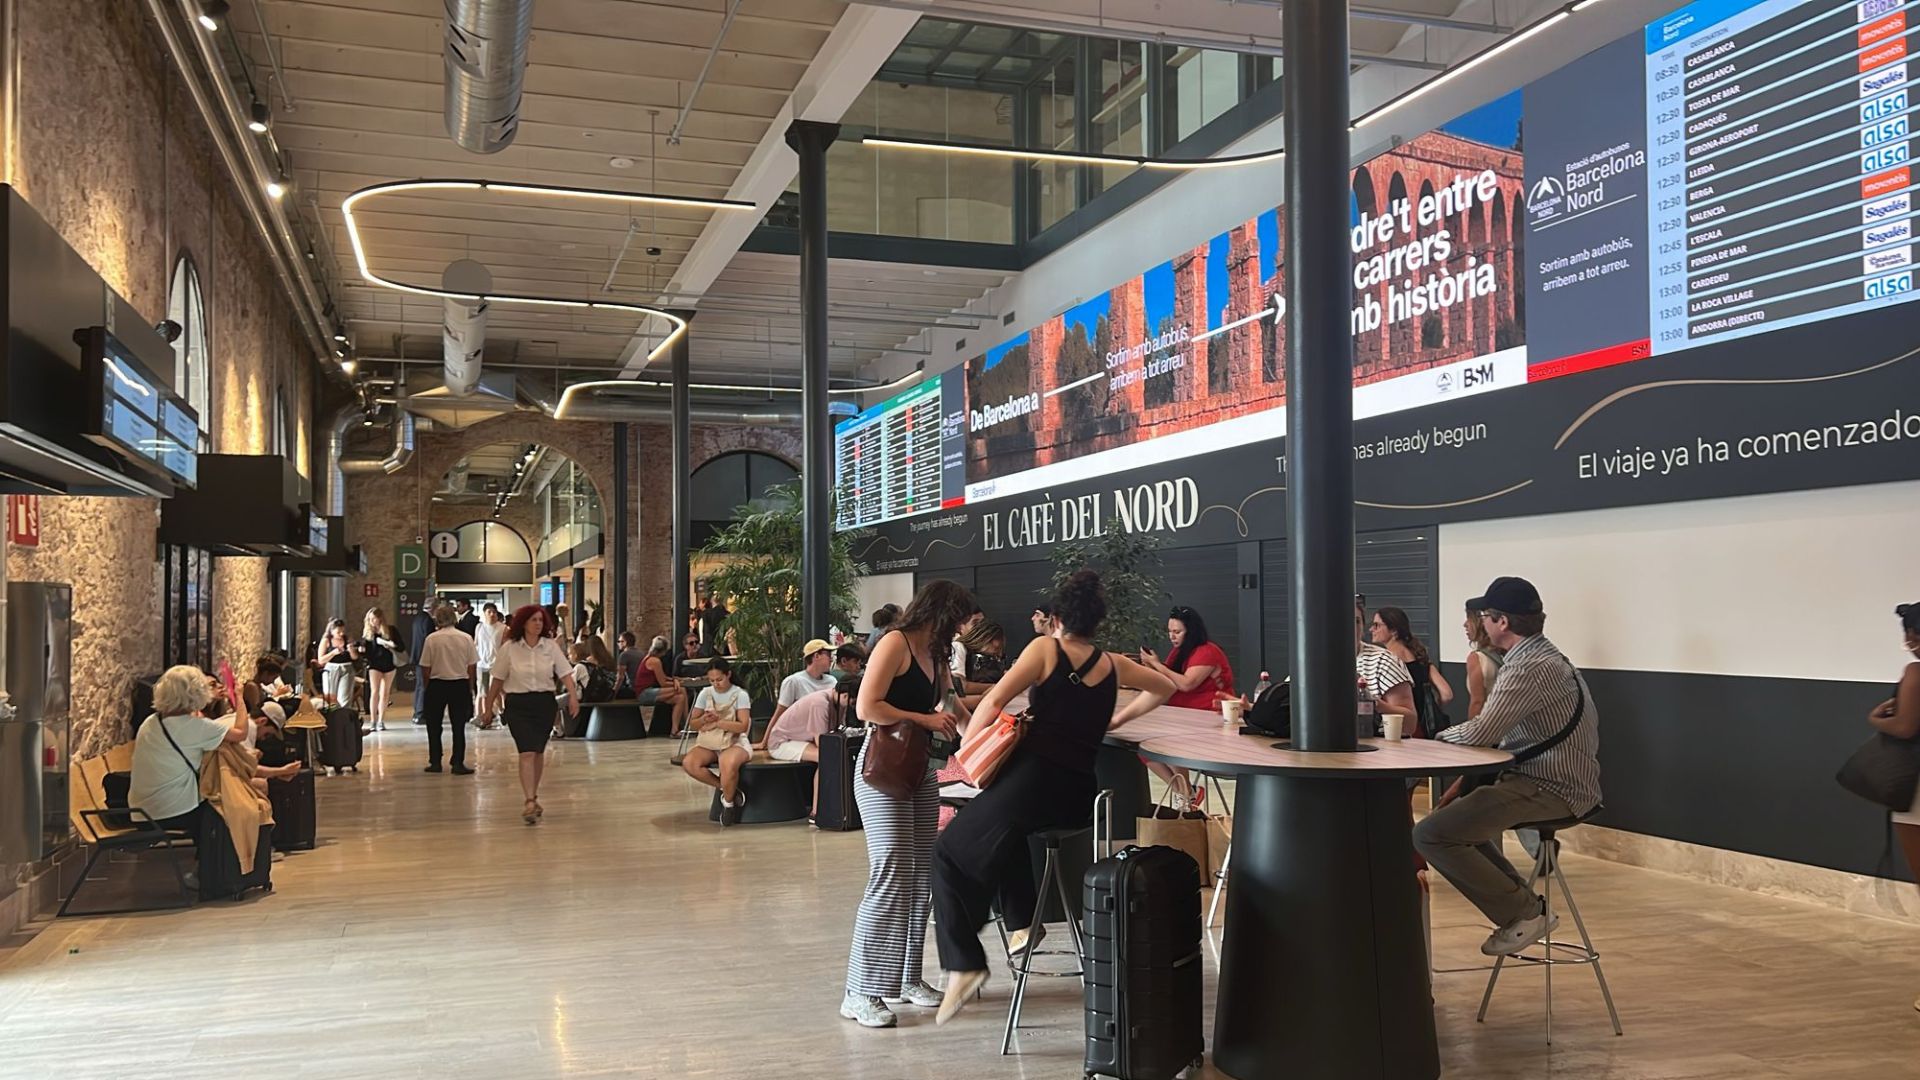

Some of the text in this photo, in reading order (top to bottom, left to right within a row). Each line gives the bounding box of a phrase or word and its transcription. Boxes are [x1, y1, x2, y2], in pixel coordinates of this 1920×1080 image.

[1655, 41, 1736, 81] 08:30 CASABLANCA
[1656, 64, 1736, 102] 10:30 CASABLANCA
[1656, 108, 1680, 124] 12:30
[1688, 97, 1711, 111] TOSSA
[1711, 94, 1722, 103] DE
[1722, 85, 1740, 98] MAR
[1656, 130, 1680, 146] 12:30
[1688, 112, 1728, 133] CADAQUÉS
[1657, 94, 1905, 190] 12:30 LLEIDA alsa
[1657, 152, 1680, 168] 12:30
[1689, 124, 1759, 155] GIRONA-AEROPORT
[1566, 142, 1631, 172] Estació d'autobusos
[1566, 150, 1646, 192] Barcelona
[1658, 120, 1906, 211] 12:30 BERGA alsa
[1529, 196, 1562, 214] BARCELONA
[1567, 182, 1604, 212] Nord
[1658, 146, 1906, 232] 12:30 VALENCIA alsa
[1350, 169, 1497, 253] dre't entre
[1538, 206, 1554, 218] NORD
[1354, 229, 1451, 290] carrers
[1540, 236, 1633, 274] Sortim amb autobús,
[1659, 240, 1682, 254] 12:45
[1690, 230, 1722, 245] L'ESCALA
[1659, 262, 1682, 276] 12:55
[1691, 252, 1718, 268] PINEDA
[1718, 250, 1729, 260] DE
[1730, 245, 1748, 256] MAR
[1388, 256, 1496, 324] història
[1542, 258, 1630, 292] arribem a tot arreu.
[1660, 284, 1682, 298] 13:00
[1691, 272, 1729, 289] CARDEDEU
[1660, 306, 1683, 320] 13:00
[1691, 302, 1702, 312] LA
[1702, 296, 1723, 310] ROCA
[1723, 290, 1754, 306] VILLAGE
[1660, 276, 1910, 342] 13:00 ANDORRA (DIRECTE) alsa
[1106, 347, 1132, 370] Sortim
[1132, 338, 1152, 360] amb
[1110, 370, 1141, 390] arribem
[1142, 366, 1148, 380] a
[1148, 360, 1160, 378] tot
[970, 410, 984, 432] De
[984, 394, 1031, 428] Barcelona
[1031, 392, 1039, 410] a
[1377, 430, 1430, 456] already
[1433, 423, 1486, 448] begun
[1578, 409, 1920, 478] El viaje ya ha comenzado
[983, 477, 1199, 550] EL CAFÈ DEL NORD
[402, 552, 421, 574] D
